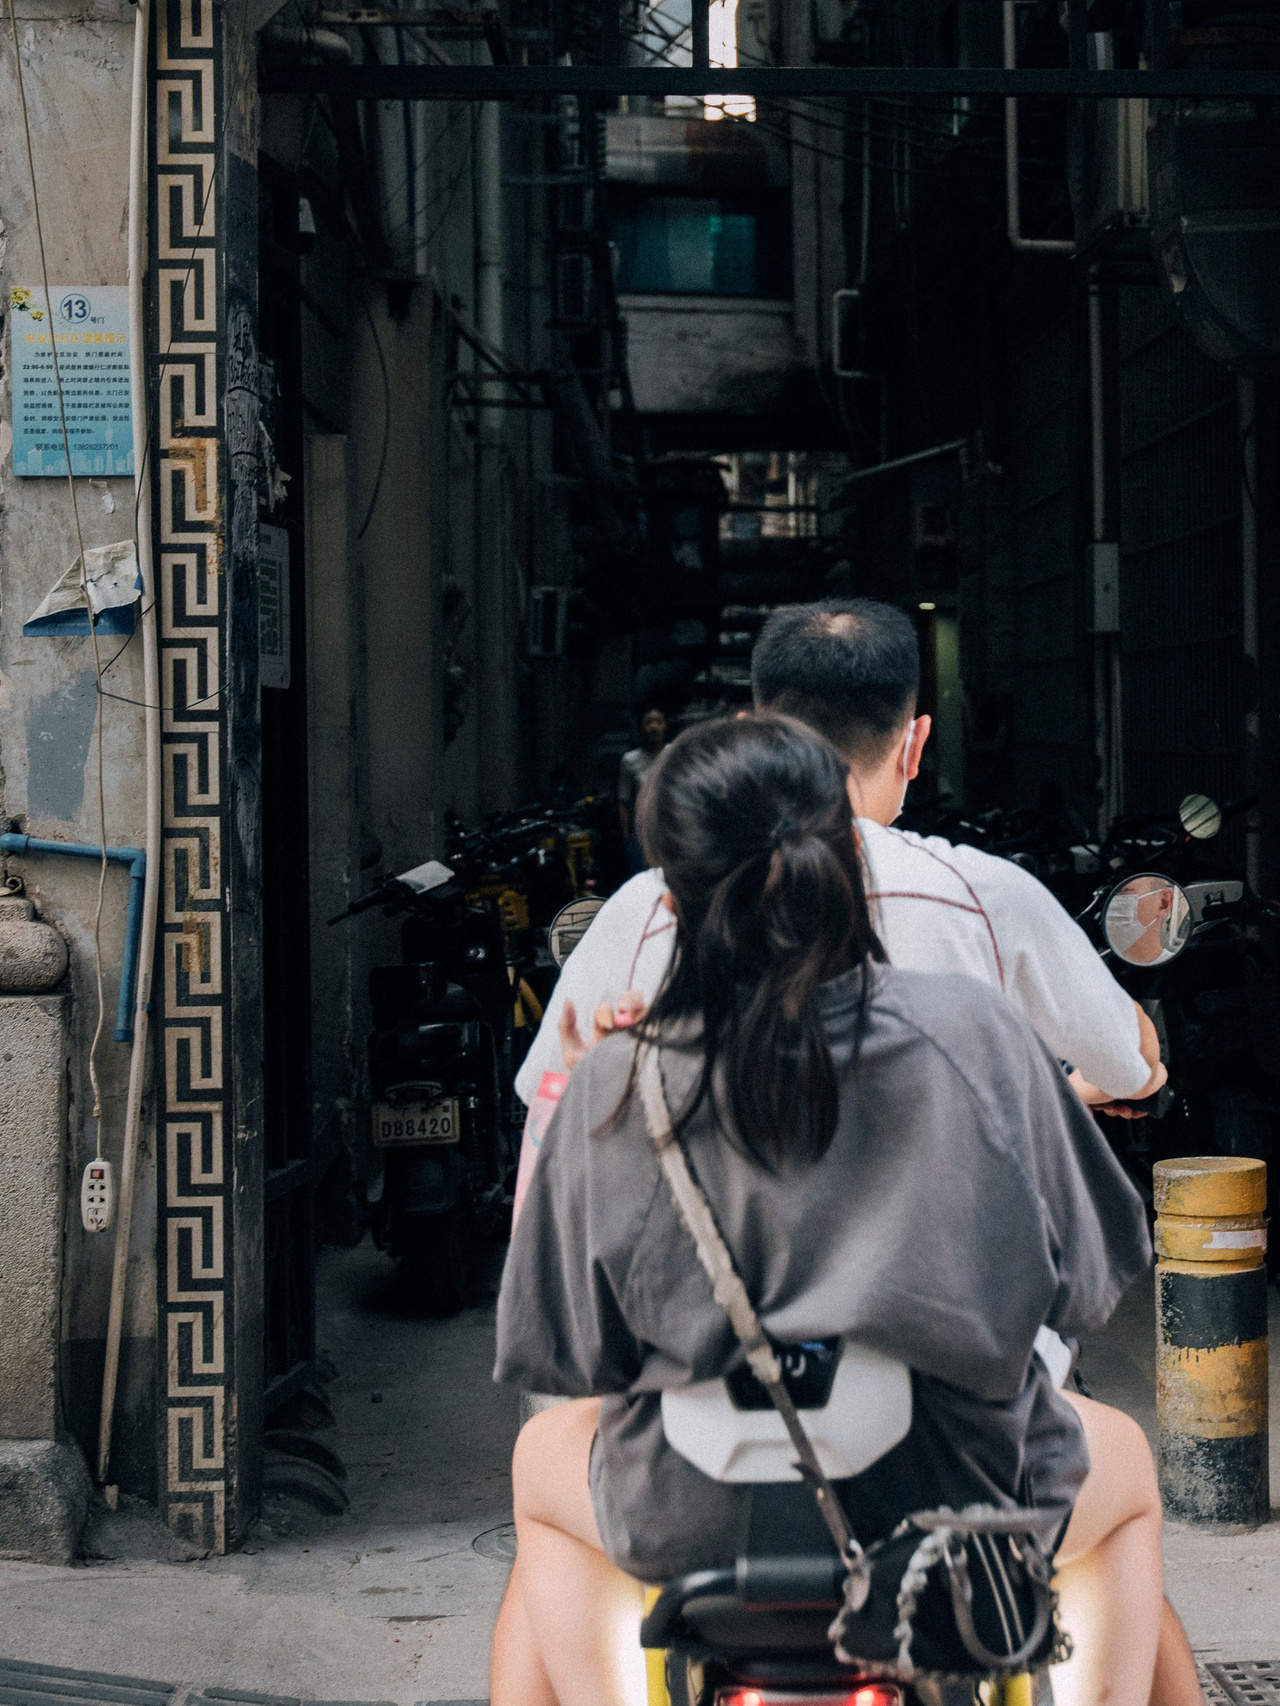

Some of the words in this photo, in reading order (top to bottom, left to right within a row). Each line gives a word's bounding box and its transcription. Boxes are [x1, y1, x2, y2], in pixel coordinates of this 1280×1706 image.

[64, 299, 87, 319] 13
[91, 316, 104, 324] 号门
[381, 1117, 451, 1138] D88420
